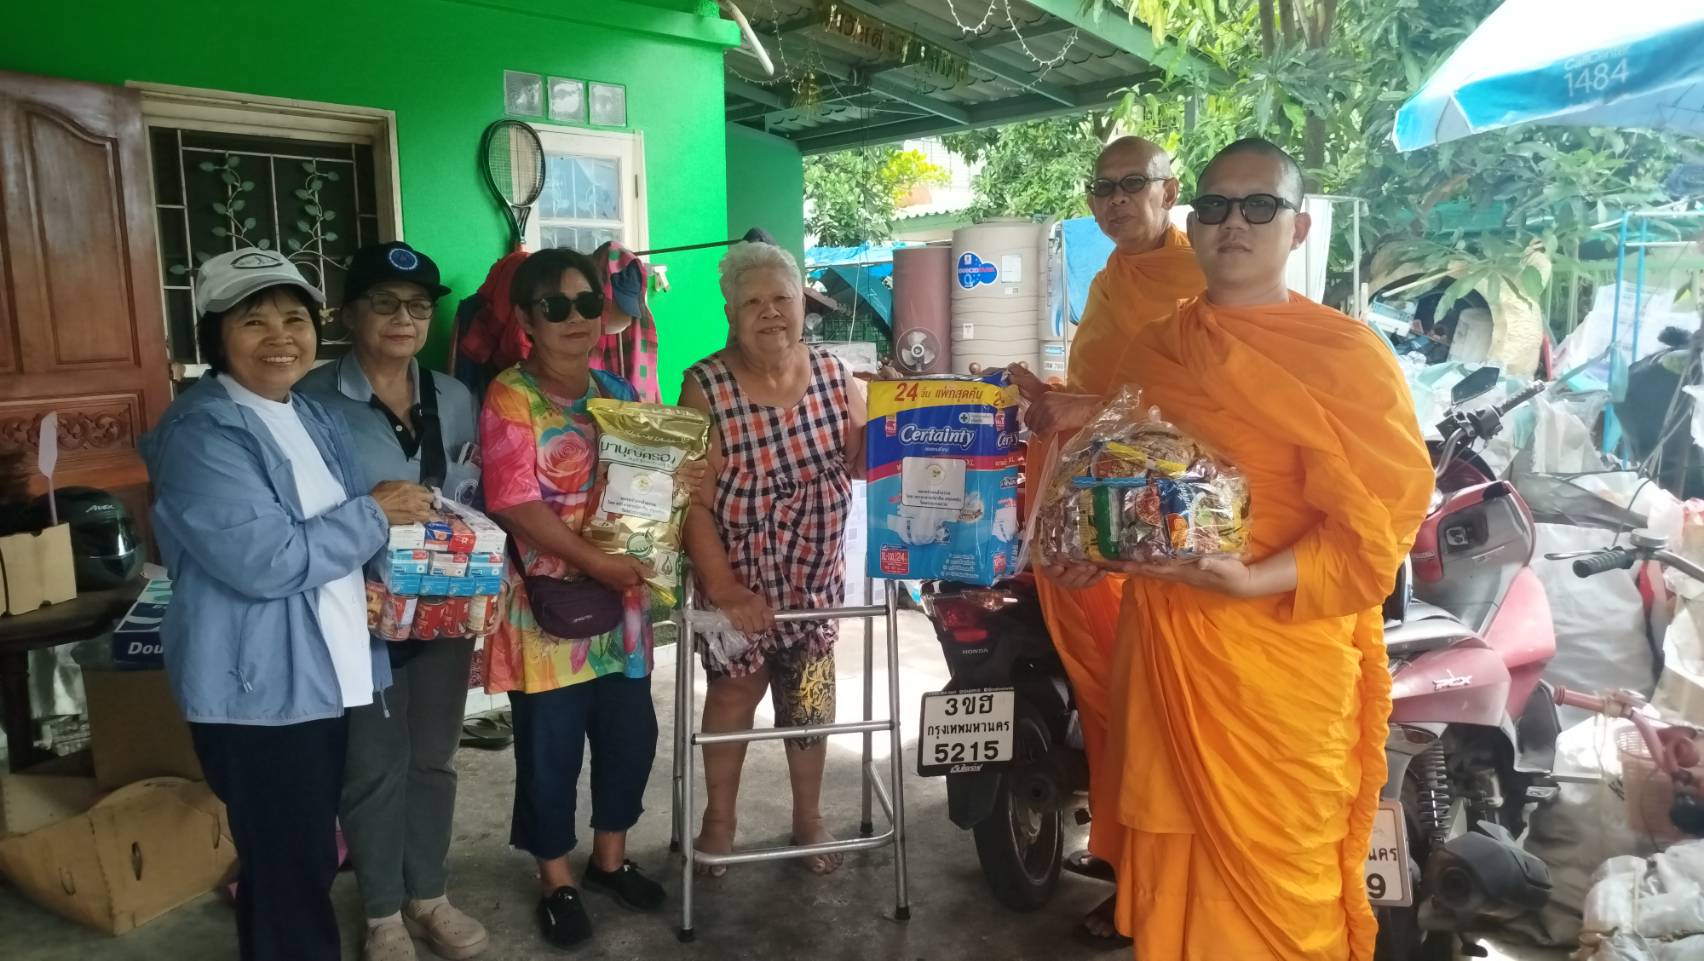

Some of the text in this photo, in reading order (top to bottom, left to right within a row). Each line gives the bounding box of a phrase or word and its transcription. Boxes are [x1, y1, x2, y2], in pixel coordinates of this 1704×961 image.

[1563, 57, 1630, 97] 1484
[894, 382, 919, 402] 24
[900, 424, 975, 448] Certainty
[927, 721, 1010, 739] กรุงเทพมหานคร
[935, 740, 999, 763] 5215
[1366, 873, 1386, 899] 9
